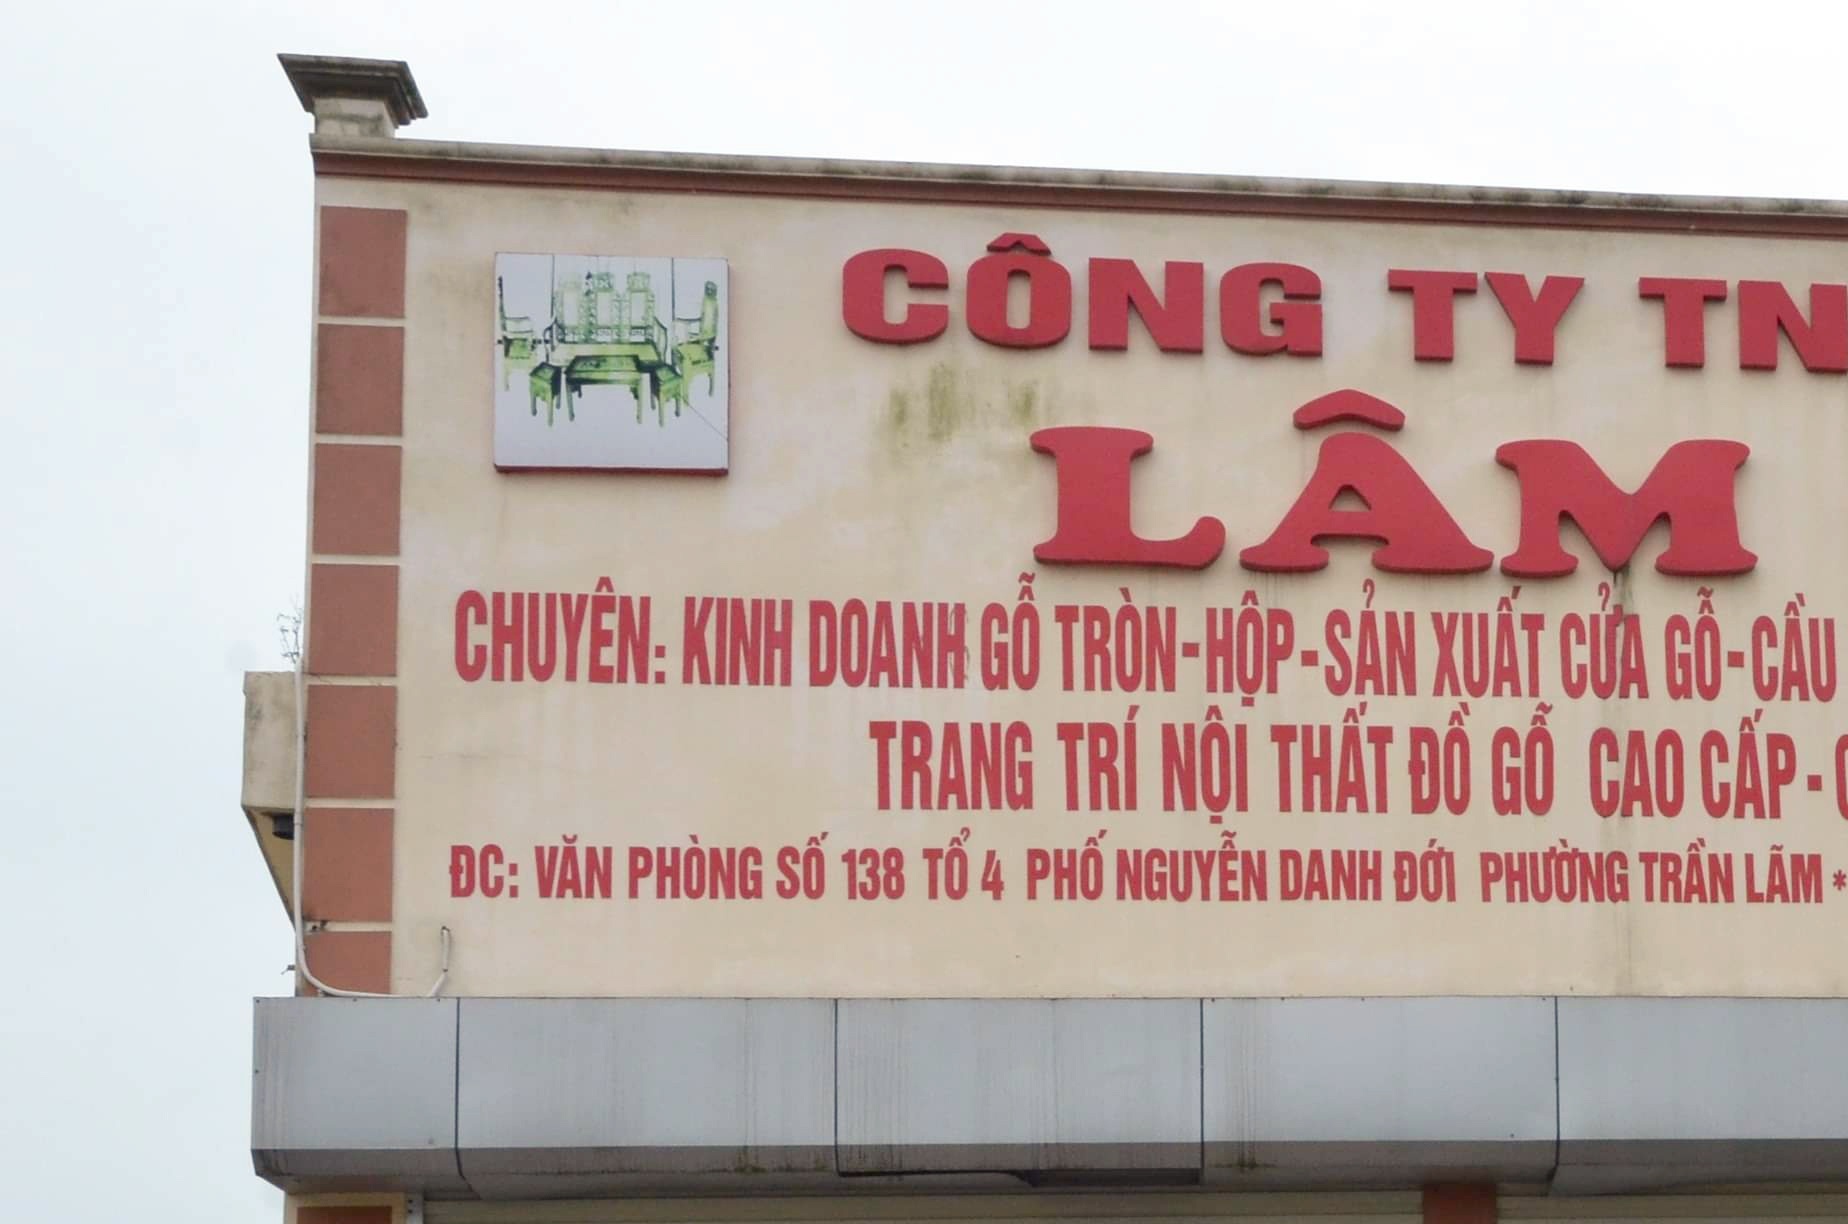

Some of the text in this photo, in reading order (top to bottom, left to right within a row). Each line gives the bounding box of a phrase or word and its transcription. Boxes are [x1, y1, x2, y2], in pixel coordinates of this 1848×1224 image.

[842, 232, 1324, 357] CÔNG
[1388, 269, 1584, 365] TY
[1030, 388, 1759, 577] LÂM
[455, 576, 666, 684] CHUYÊN:
[682, 596, 793, 686] KINH
[809, 598, 965, 688] DOANH
[981, 572, 1040, 690] GỖ
[1432, 586, 1546, 698] XUẤT
[1560, 583, 1648, 699] CỬA
[868, 720, 1034, 811] TRANG
[1056, 704, 1138, 811] TRÍ
[1161, 704, 1248, 825] NỘI
[1270, 703, 1394, 814] THẤT
[1408, 702, 1472, 816] ĐỒ
[1491, 703, 1555, 816] GỖ
[1590, 727, 1685, 817] CAO
[1700, 709, 1797, 820] CẤP
[450, 844, 518, 897] ĐC:
[535, 834, 613, 898] VĂN
[628, 835, 763, 900] PHÒNG
[776, 831, 829, 900] SỐ
[841, 848, 906, 900] 138
[923, 827, 970, 901] TỔ
[981, 849, 1004, 900] 4
[1027, 829, 1107, 901] PHỐ
[1116, 831, 1268, 902] NGUYỄN
[1280, 848, 1382, 901] DANH
[1393, 838, 1456, 902] ĐỚI
[1480, 838, 1631, 903] PHƯỜNG
[1639, 837, 1735, 904] TRẦN
